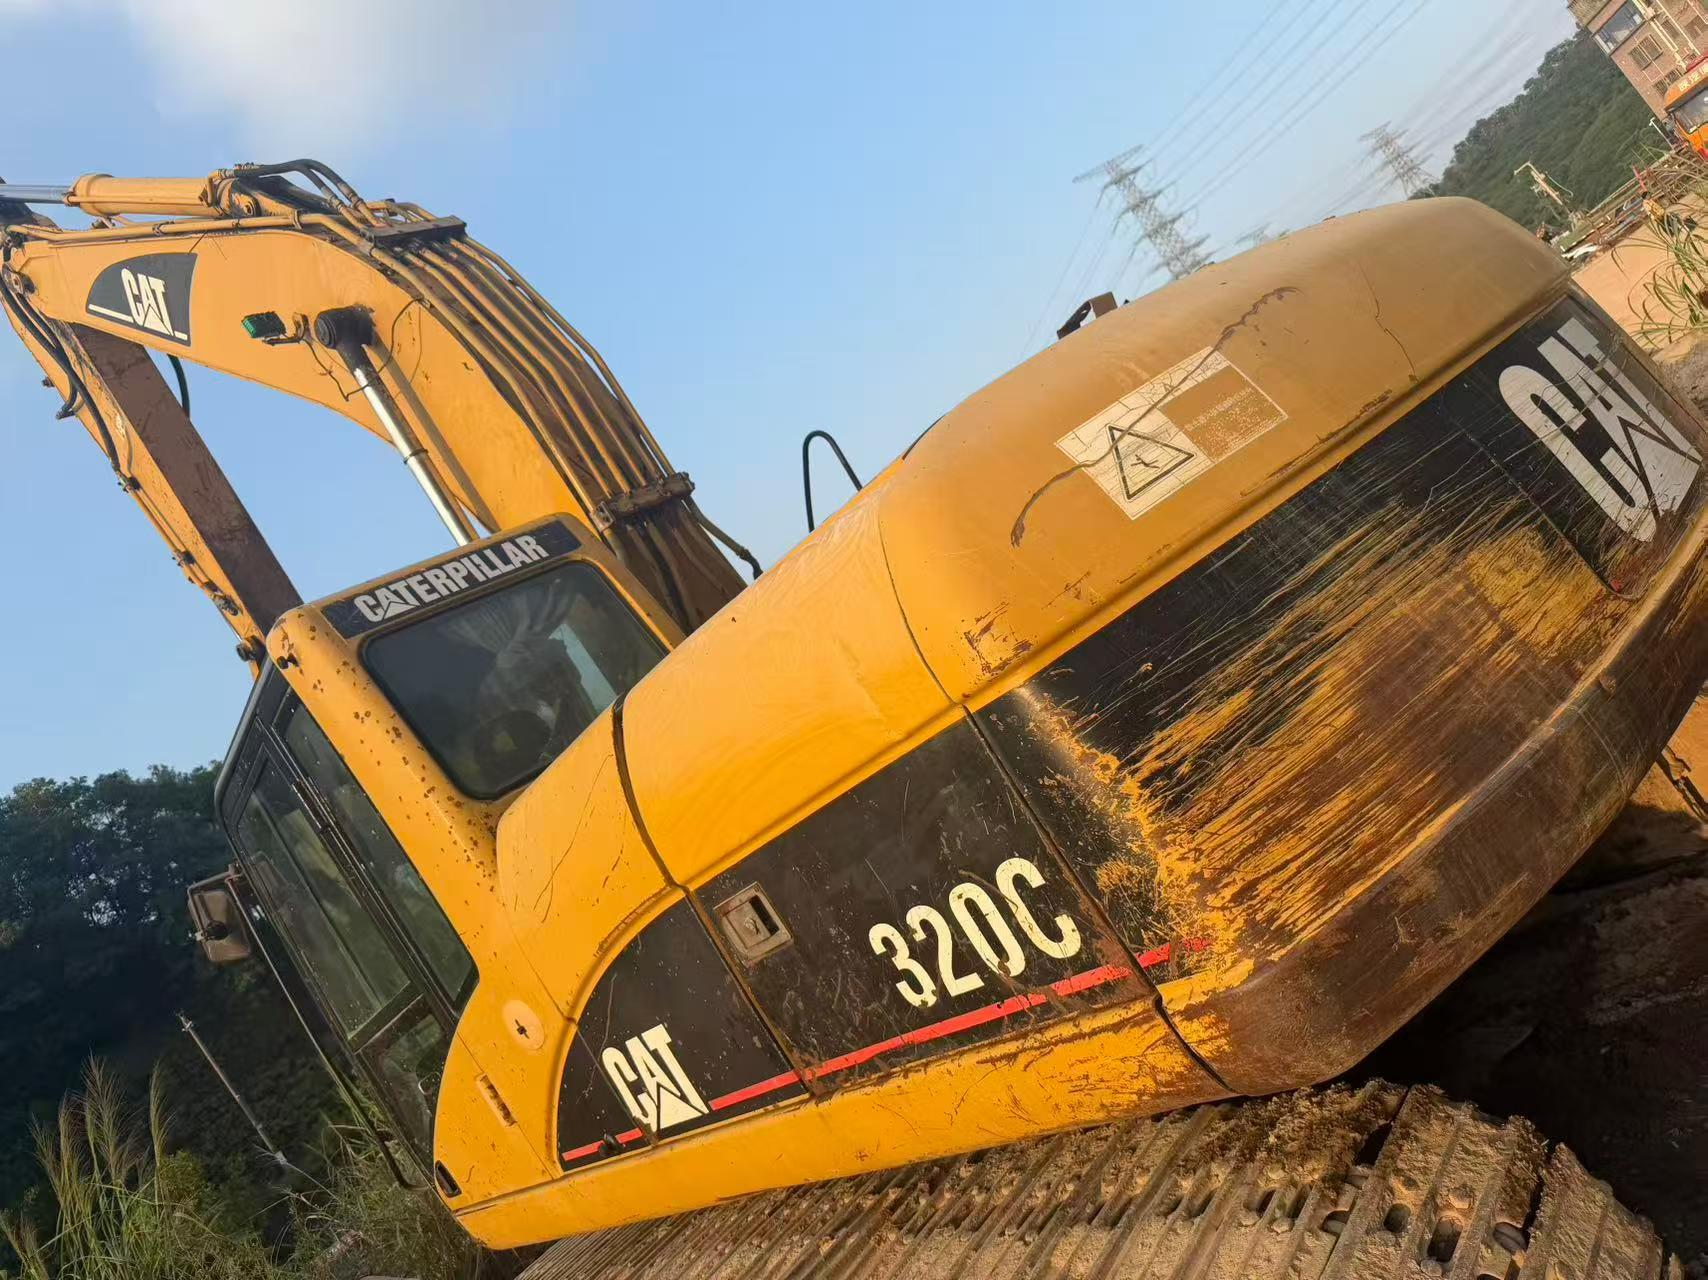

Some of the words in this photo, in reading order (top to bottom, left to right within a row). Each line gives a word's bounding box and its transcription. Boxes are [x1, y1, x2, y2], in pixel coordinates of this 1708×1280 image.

[121, 268, 174, 336] CAT
[1498, 317, 1702, 542] CAT
[353, 535, 550, 623] CATERPILLAR
[869, 857, 1081, 1008] 320C
[601, 1023, 709, 1132] CAT
